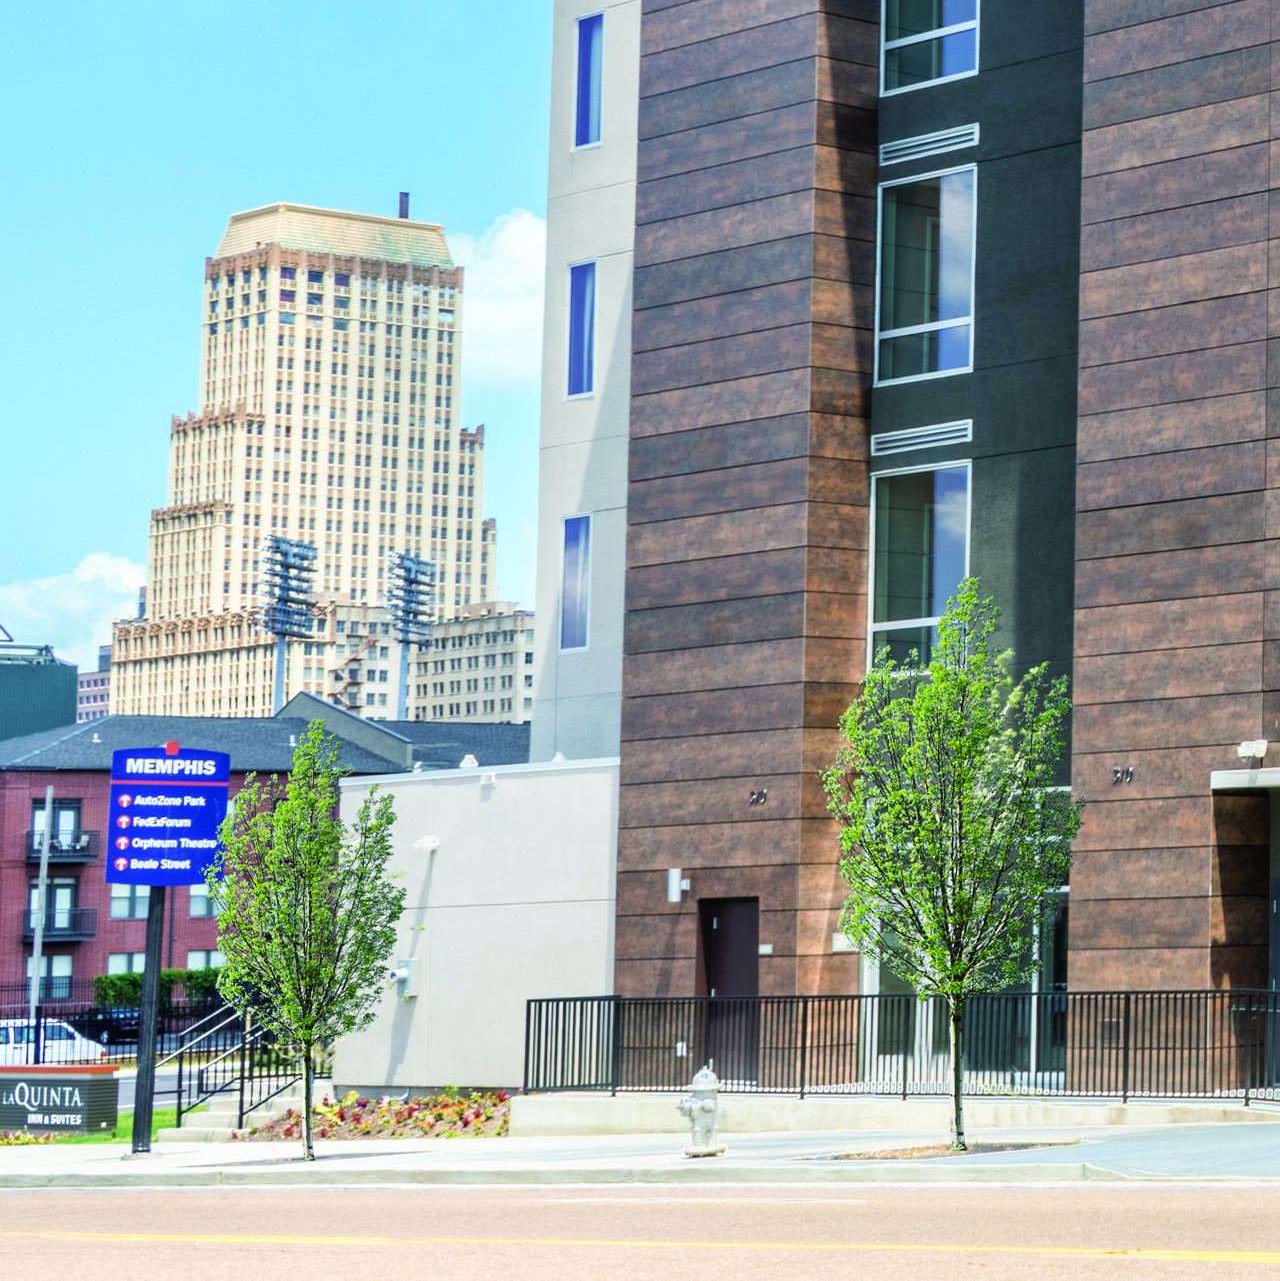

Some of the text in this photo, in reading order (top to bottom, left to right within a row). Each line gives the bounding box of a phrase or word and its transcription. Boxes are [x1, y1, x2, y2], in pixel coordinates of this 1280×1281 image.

[126, 758, 216, 775] MEMPHIS
[134, 795, 206, 807] AutoZone Park
[132, 816, 191, 828] FedExForum
[132, 837, 217, 850] Orpheum Theatre
[130, 859, 191, 869] Beale Street
[3, 1082, 82, 1111] LA QUINTA
[27, 1114, 82, 1125] INN & SUITES
